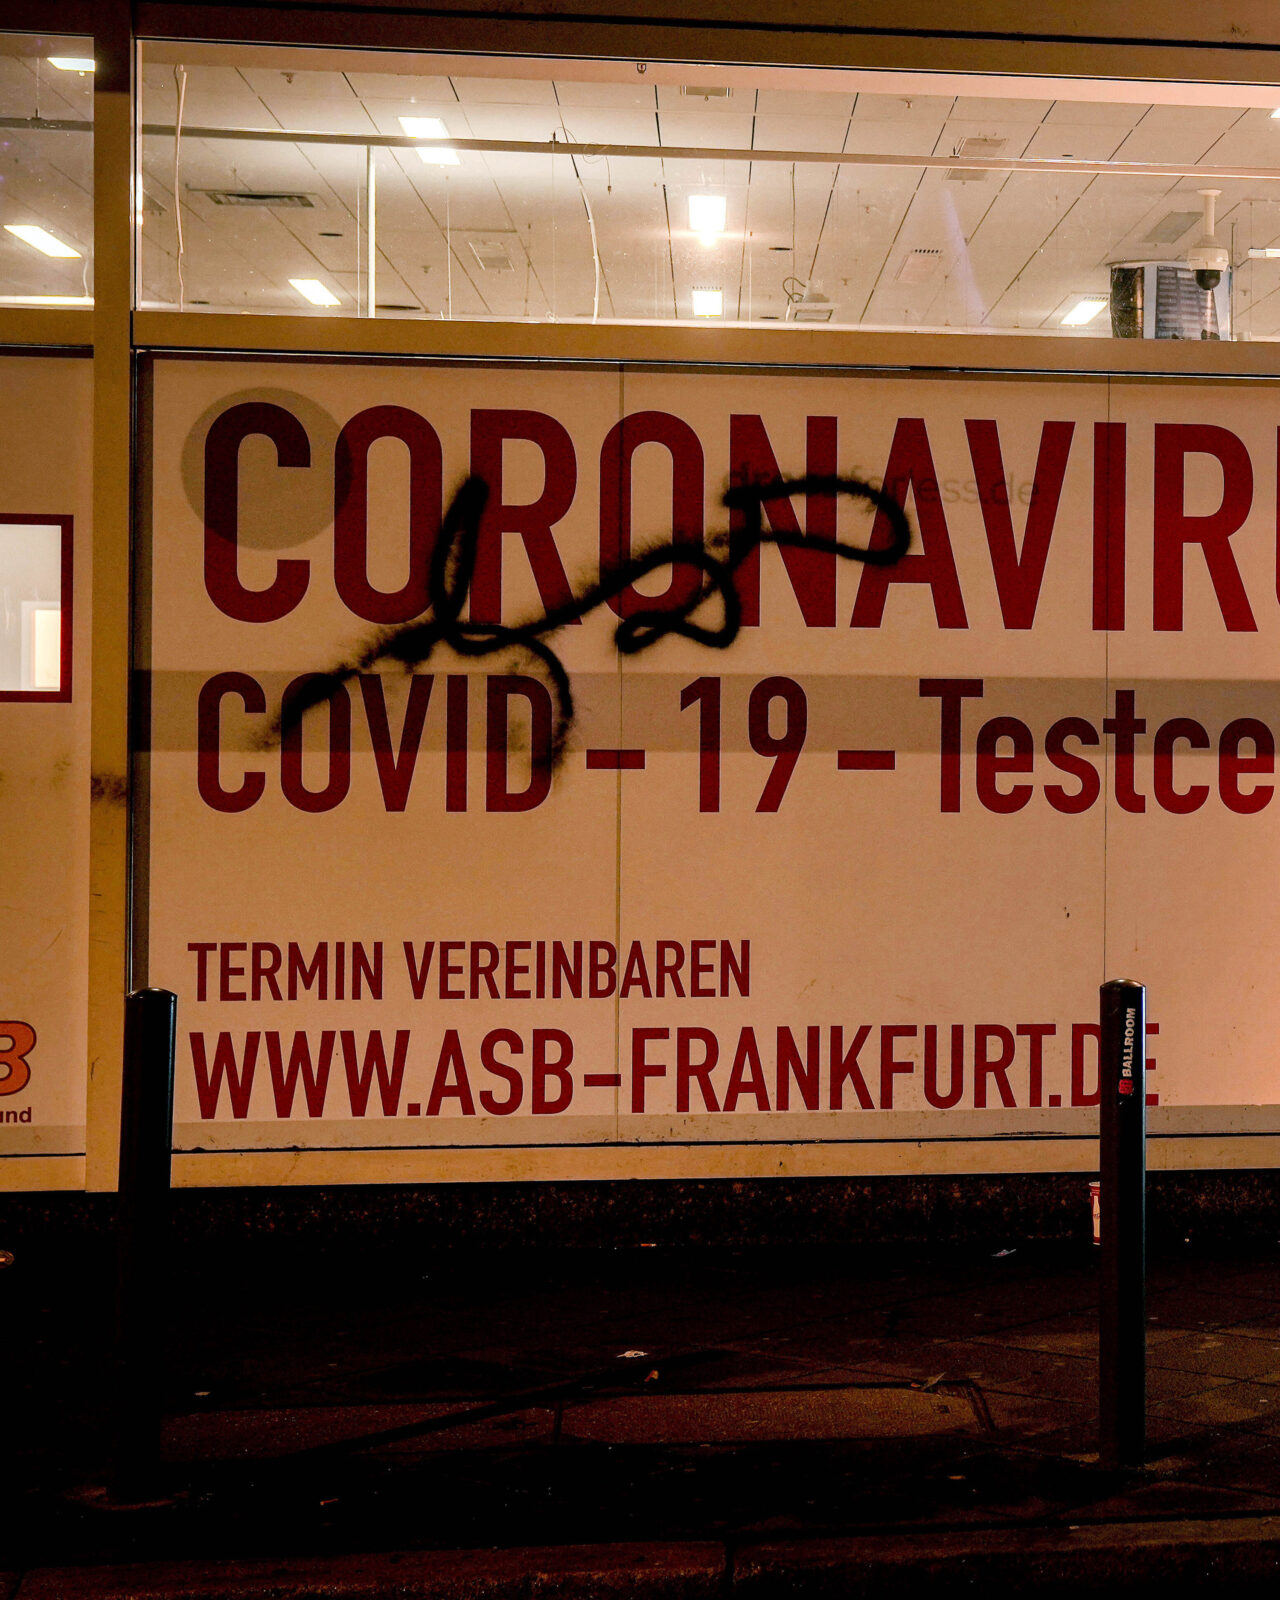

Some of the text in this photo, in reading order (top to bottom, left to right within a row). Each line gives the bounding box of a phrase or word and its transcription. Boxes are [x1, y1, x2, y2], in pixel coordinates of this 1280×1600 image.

[188, 939, 751, 1001] TERMIN VEREINBAREN
[1122, 1007, 1136, 1077] BALLROOM
